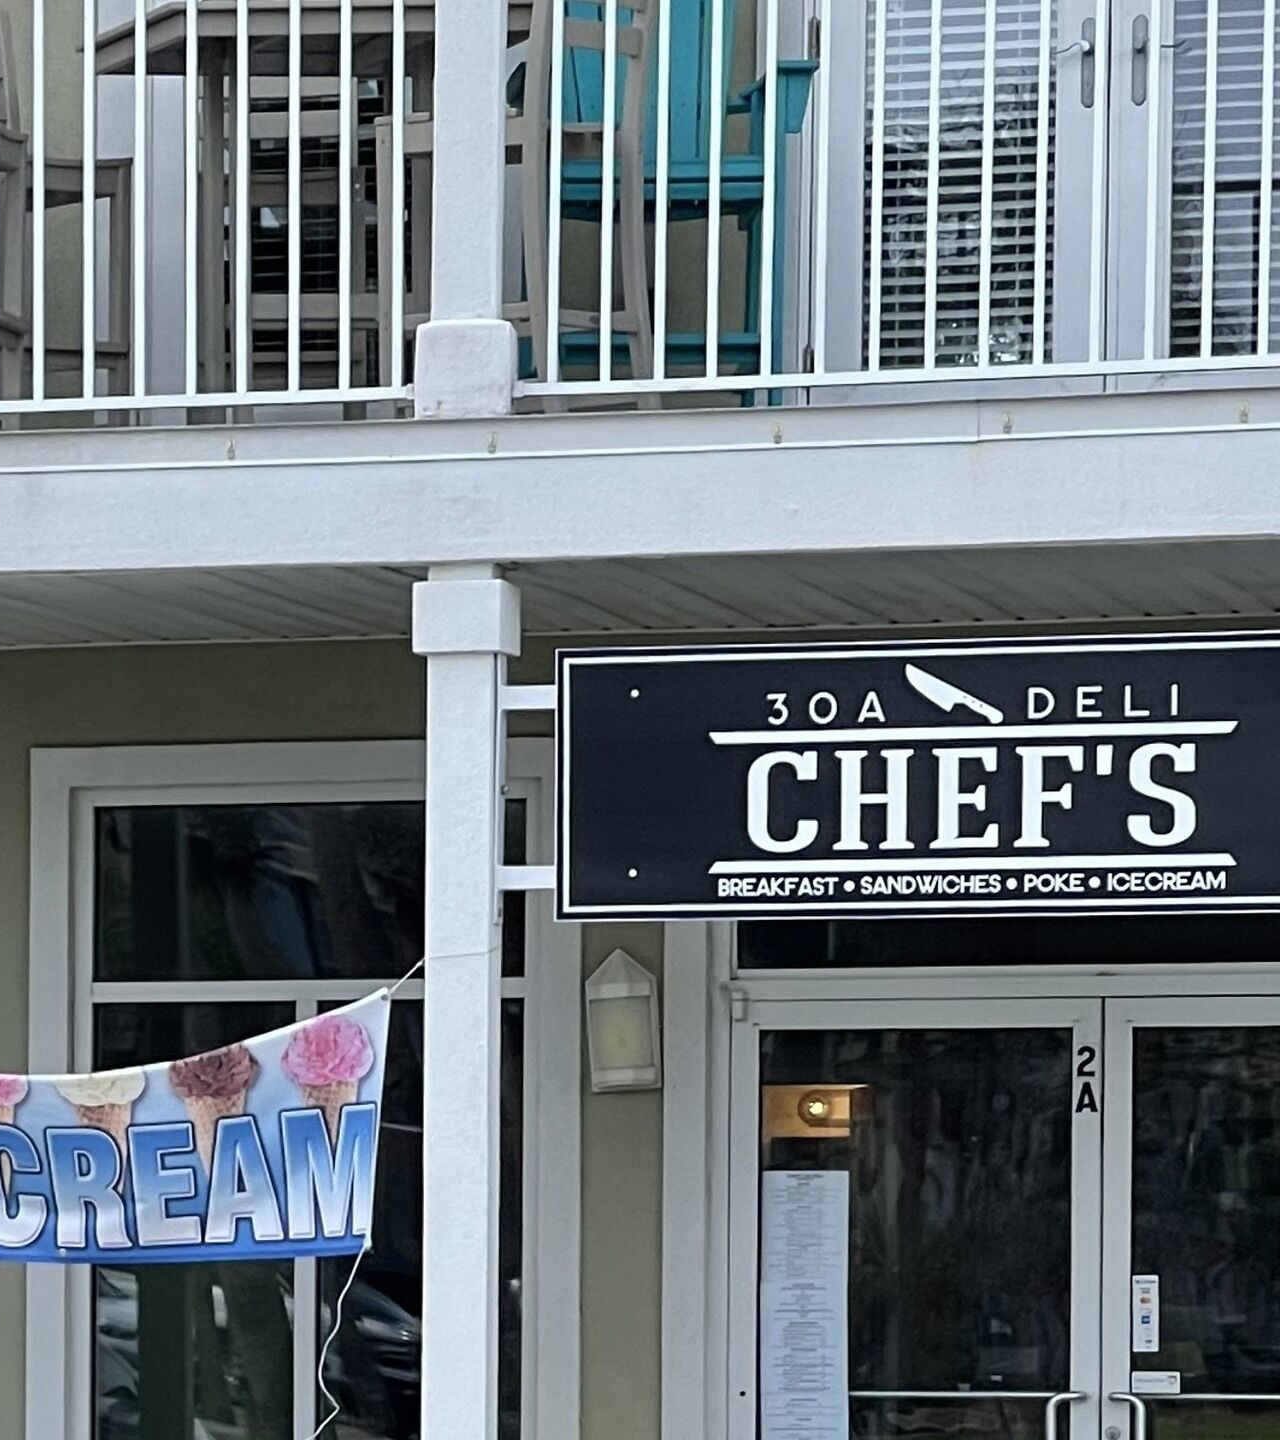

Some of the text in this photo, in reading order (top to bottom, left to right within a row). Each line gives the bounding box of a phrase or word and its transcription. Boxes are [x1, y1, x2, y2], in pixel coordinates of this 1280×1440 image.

[766, 683, 1178, 726] 30A DELI
[746, 741, 1197, 853] CHEF'S
[717, 870, 1227, 898] BREAKFAST SANDWICHES POKE ICECREAM
